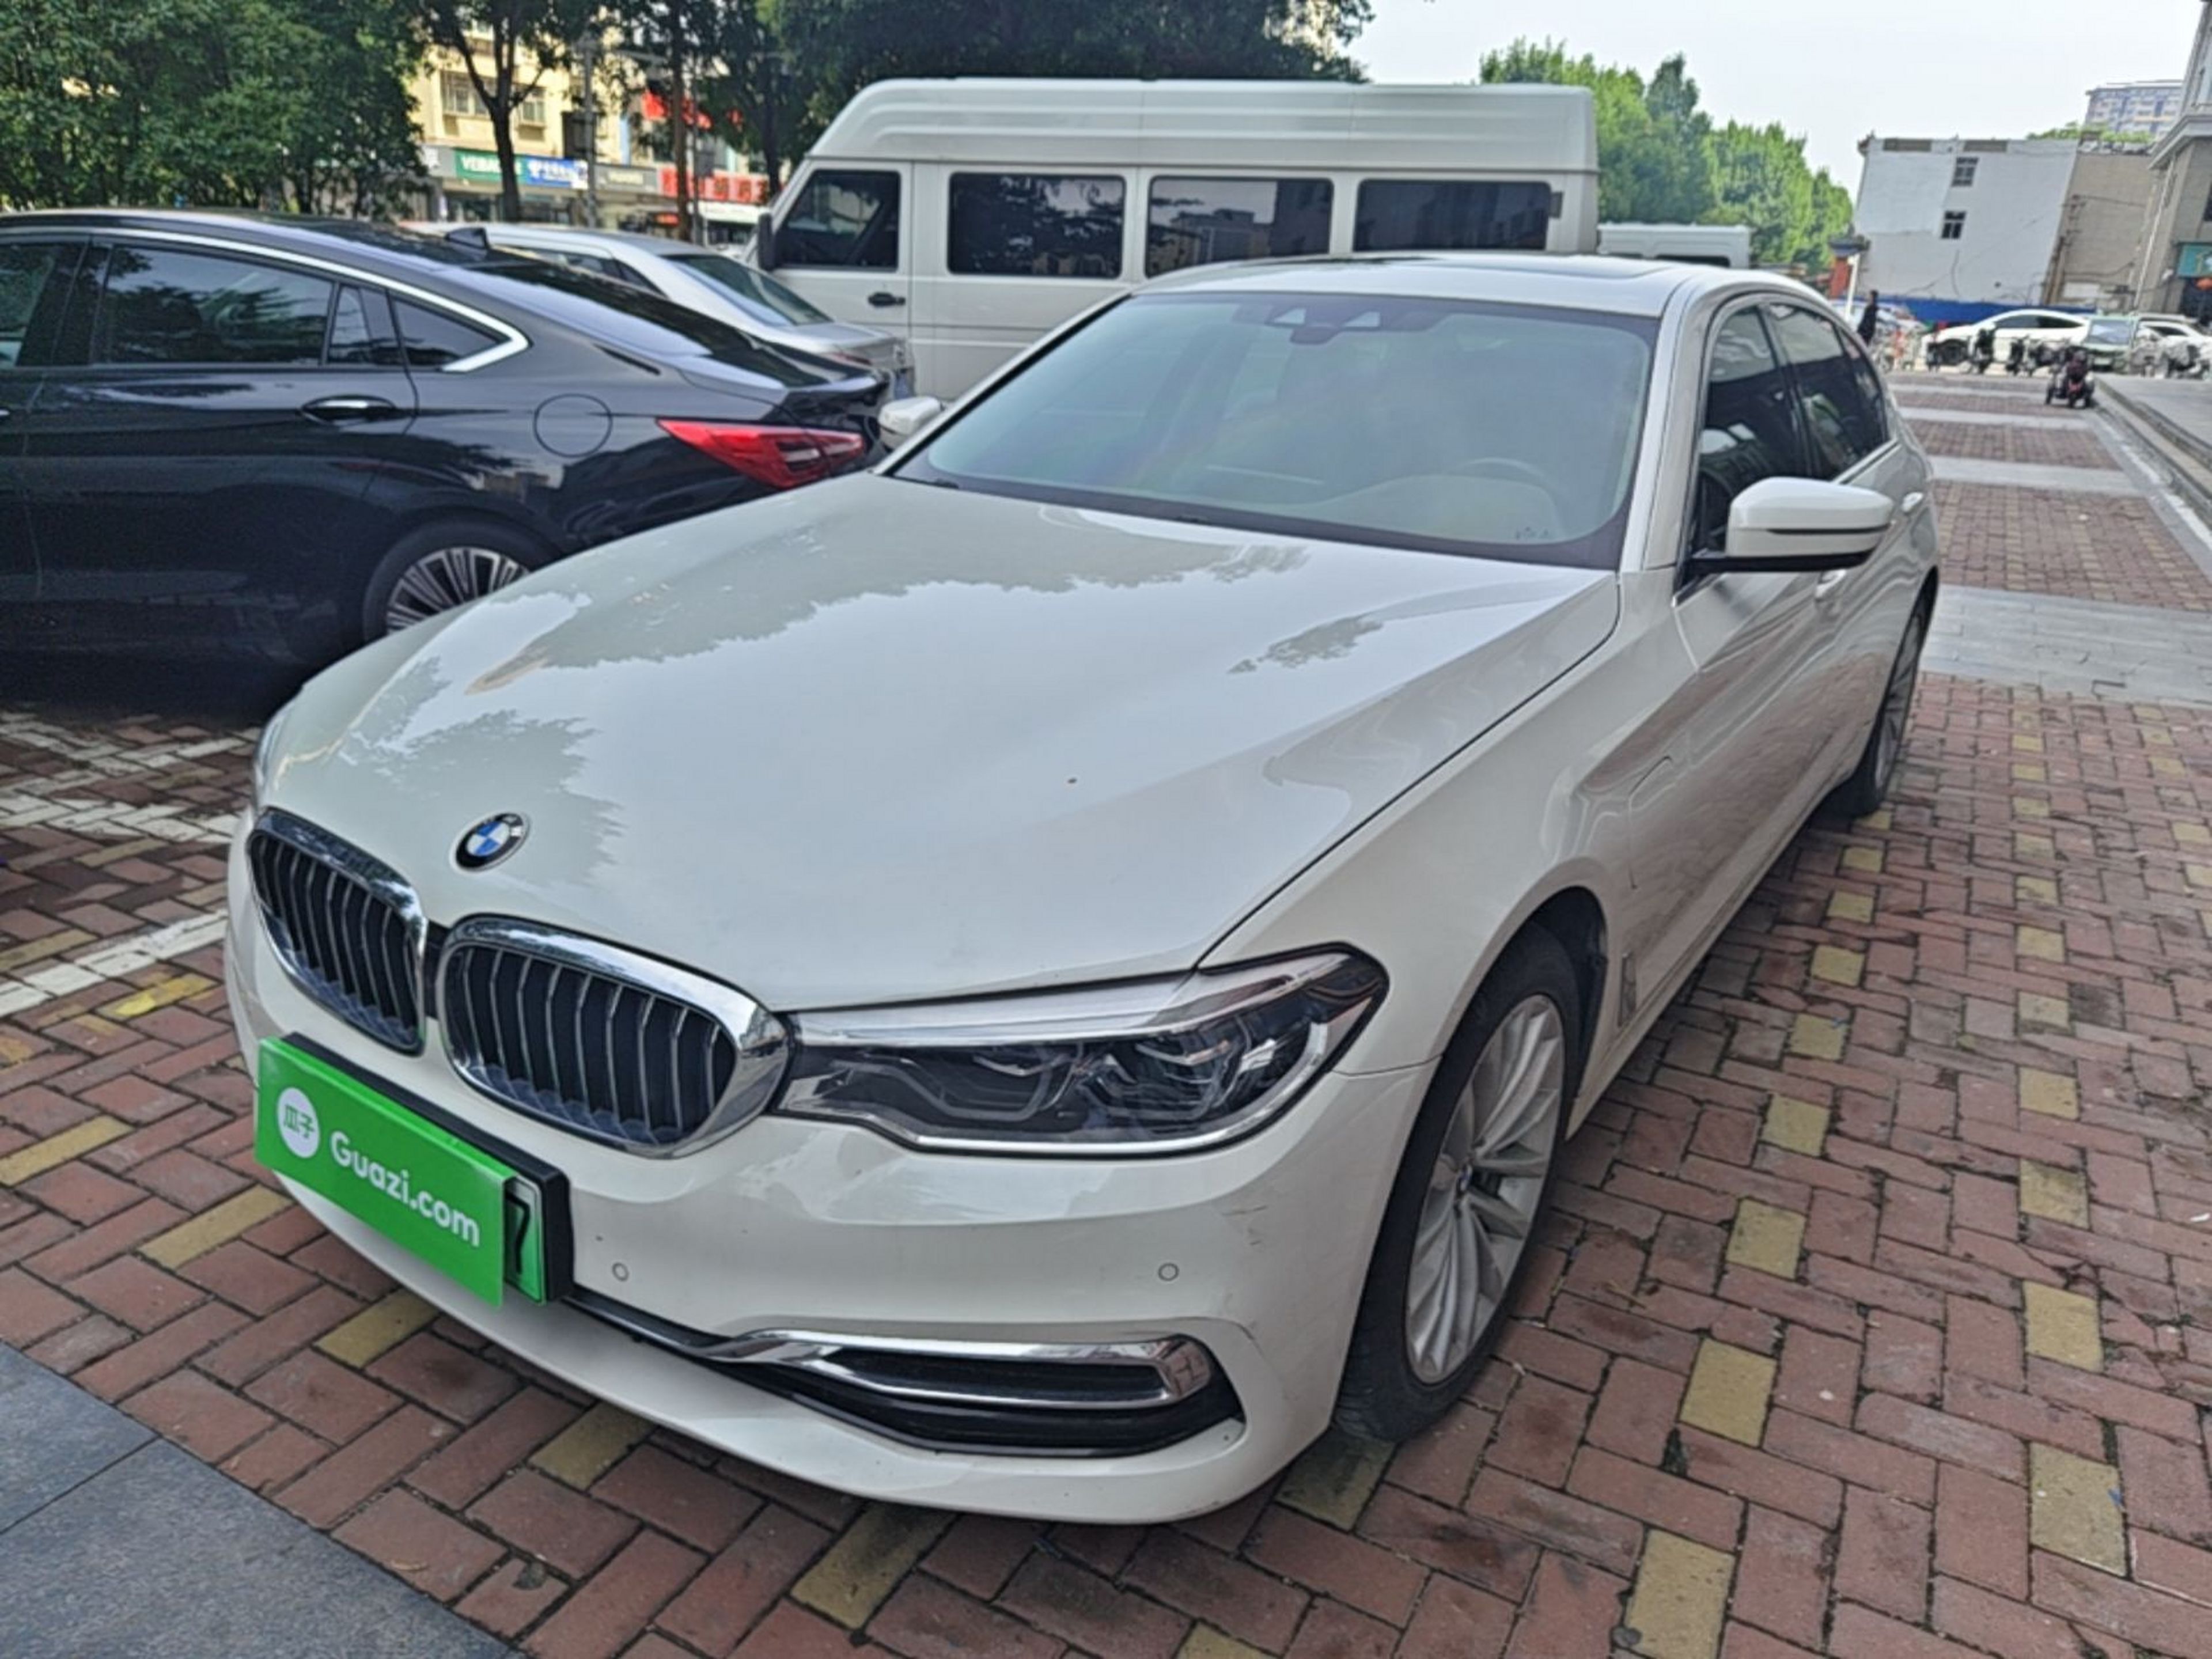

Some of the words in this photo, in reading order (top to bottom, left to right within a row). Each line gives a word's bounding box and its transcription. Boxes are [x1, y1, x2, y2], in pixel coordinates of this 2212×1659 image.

[283, 1103, 315, 1139] 瓜子
[329, 1131, 480, 1247] Guazi.com
[505, 1191, 531, 1275] 7
